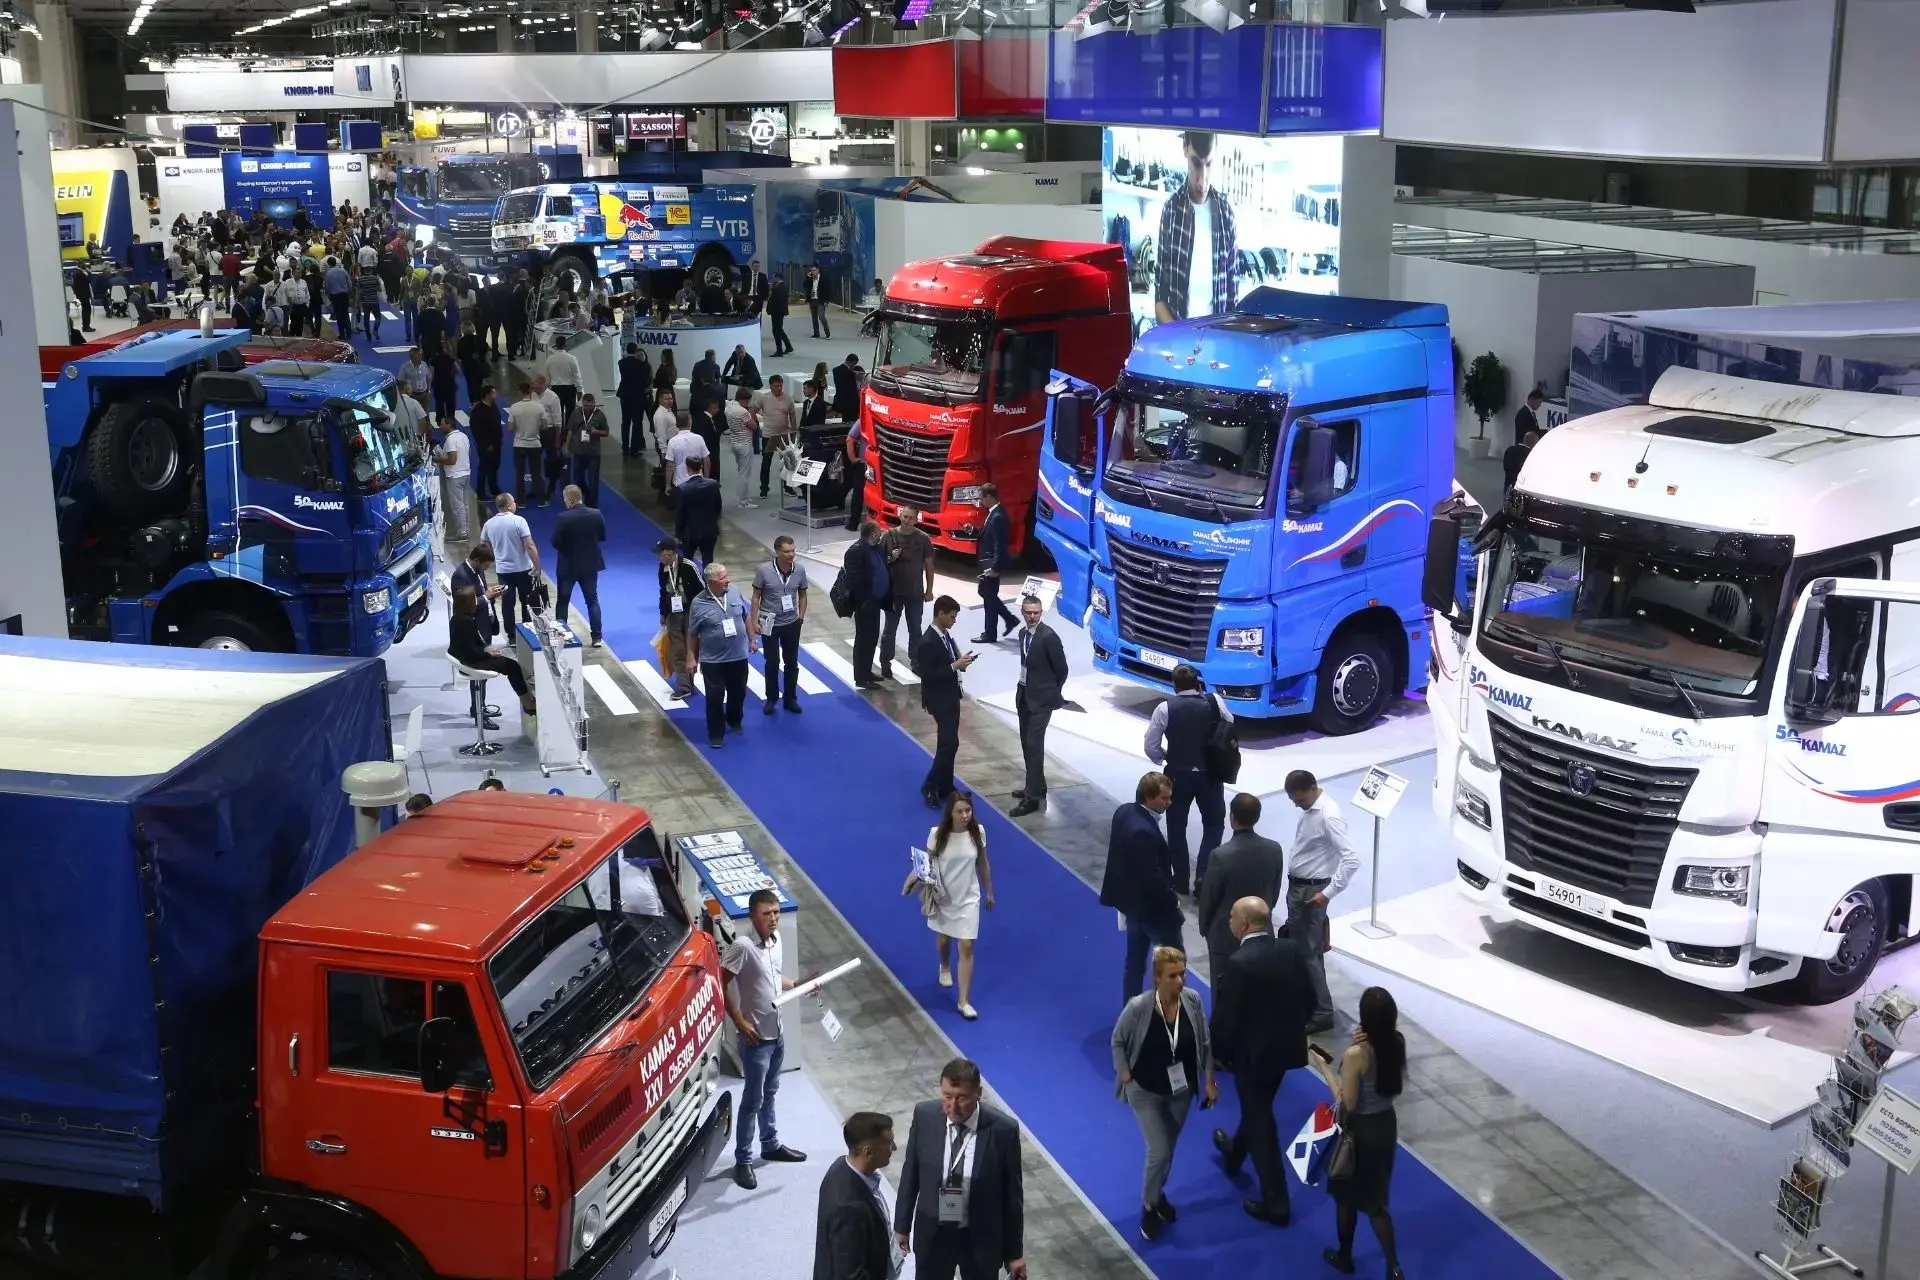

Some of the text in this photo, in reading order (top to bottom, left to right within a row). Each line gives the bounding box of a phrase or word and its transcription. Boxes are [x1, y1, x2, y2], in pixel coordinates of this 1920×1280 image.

[752, 120, 776, 141] ZF
[261, 162, 311, 170] KNORR-BREMSE
[262, 186, 290, 194] Together.
[1035, 178, 1058, 186] KAMAZ
[543, 230, 557, 239] 500
[716, 219, 750, 238] VTB
[636, 331, 678, 346] KAMAZ
[294, 495, 345, 511] 50 KAMAZ
[1105, 511, 1132, 528] KAMAZ
[1298, 521, 1323, 534] KAMAZ
[1131, 530, 1193, 552] KAMAZ
[1144, 652, 1165, 666] 54901
[1469, 665, 1533, 712] 50 KAMAZ
[1532, 715, 1638, 755] KAMAZ
[1775, 724, 1847, 757] 50 KAMAZ
[1699, 739, 1737, 752] ЛИЗИНГ
[1548, 884, 1582, 907] 54901
[640, 1026, 677, 1084] КАМАЗ
[644, 1072, 664, 1114] XXV
[697, 1004, 717, 1048] КПСС
[1879, 1107, 1895, 1120] ЕСТЬ
[656, 1200, 673, 1232] 5320
